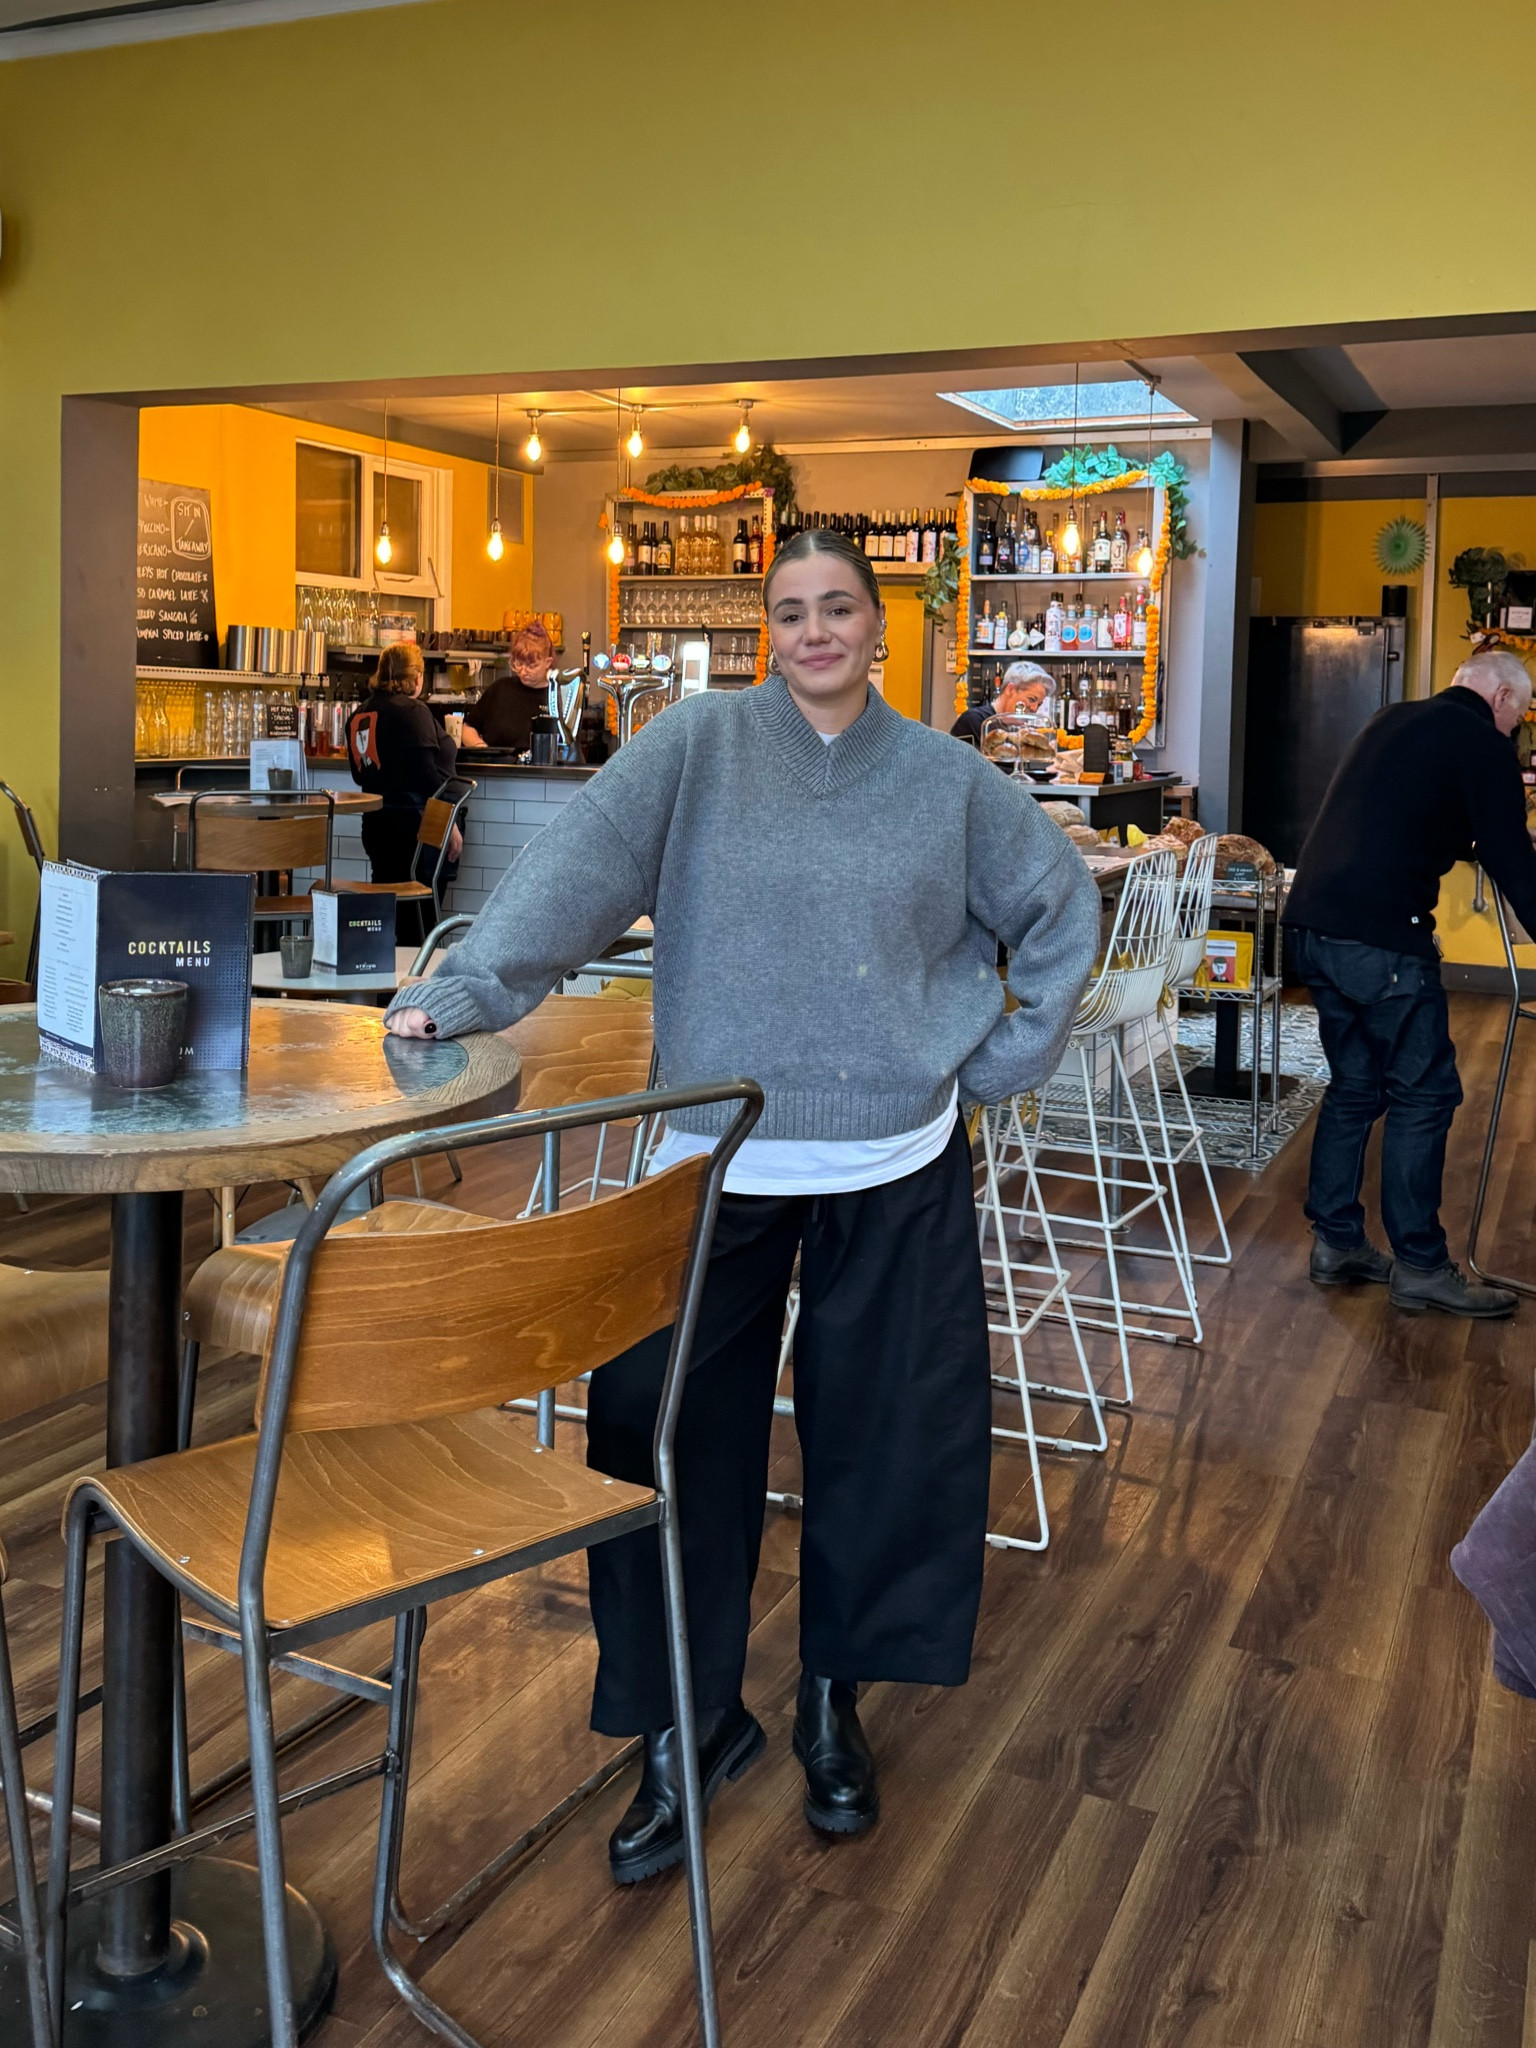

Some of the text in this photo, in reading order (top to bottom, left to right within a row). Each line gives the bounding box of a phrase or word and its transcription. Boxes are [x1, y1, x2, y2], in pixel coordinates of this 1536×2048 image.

[177, 502, 202, 518] SIT IN
[156, 567, 169, 580] HOT
[171, 568, 203, 584] CHOCOLATE
[148, 587, 177, 603] CARAMEL
[180, 589, 199, 602] LATTE
[128, 940, 211, 955] COCKTAILS
[175, 956, 210, 967] MENU
